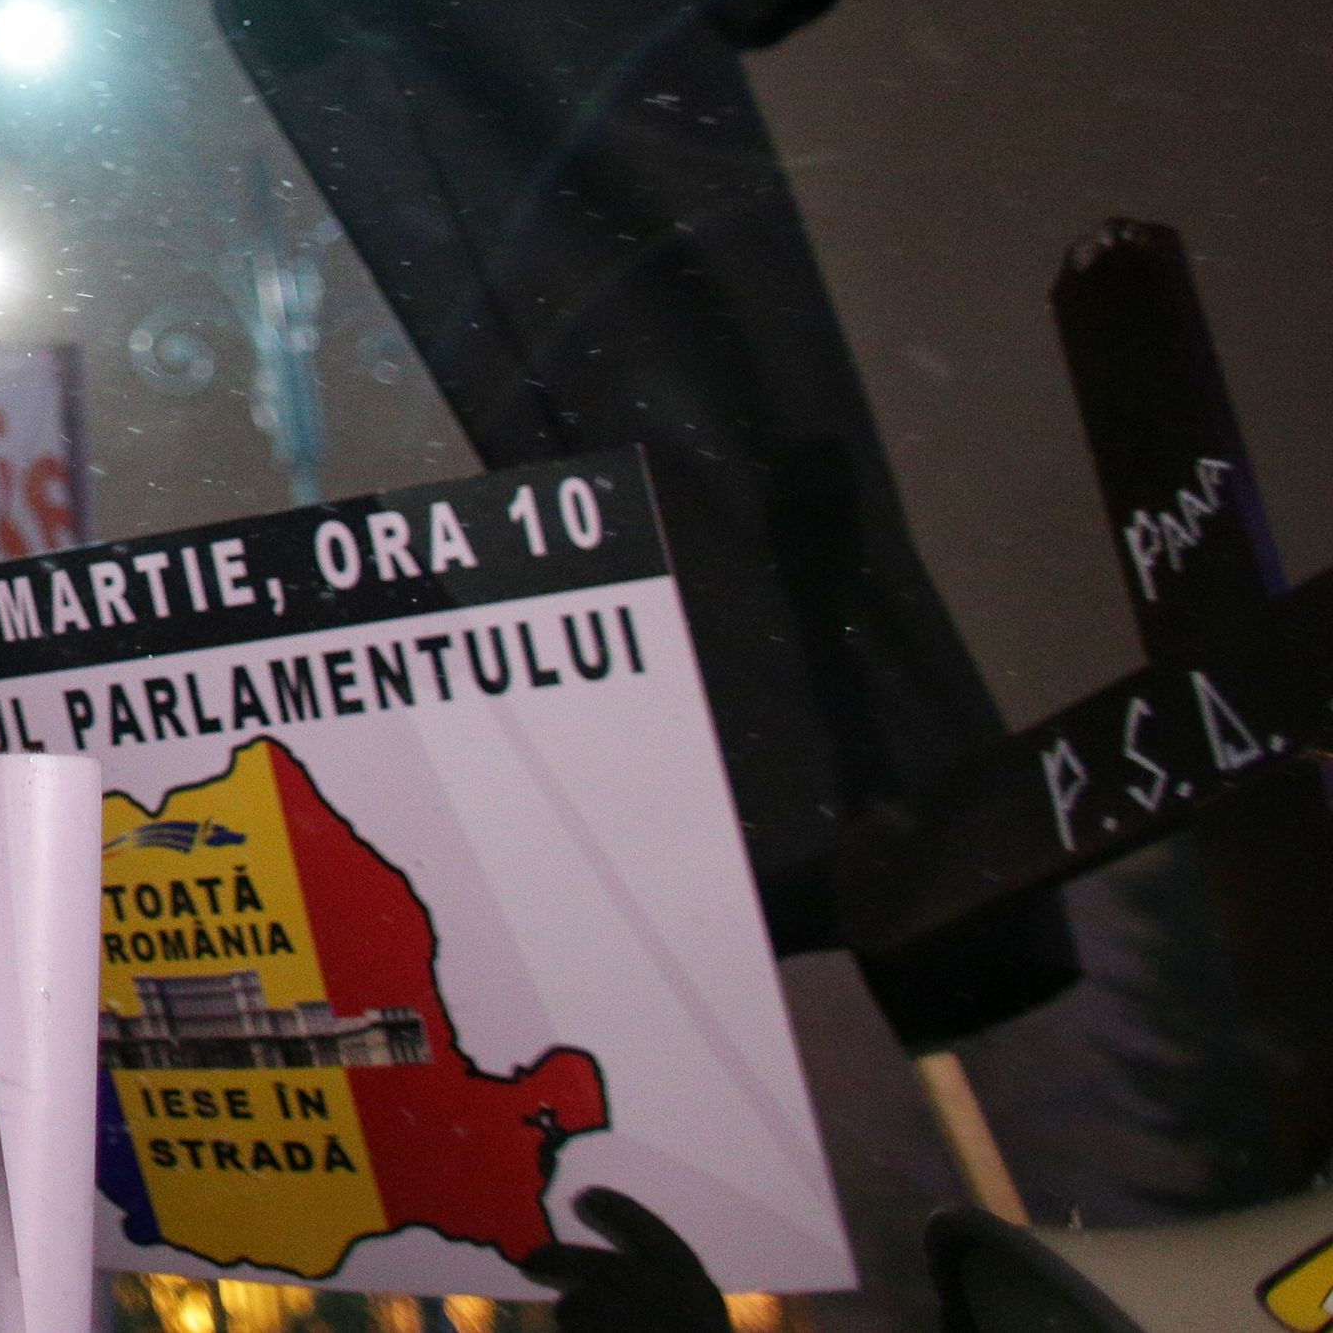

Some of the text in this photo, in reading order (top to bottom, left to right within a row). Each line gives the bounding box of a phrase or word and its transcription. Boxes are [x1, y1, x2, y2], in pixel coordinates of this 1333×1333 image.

[314, 500, 479, 591] ORA
[508, 476, 603, 558] 10
[64, 604, 646, 752] PARLAMENTULUI
[1042, 670, 1286, 852] P.S.D.
[102, 865, 264, 923] TOATĂ
[102, 918, 295, 965] ROMÂNIA
[140, 1081, 330, 1121] IESE ÎN
[148, 1133, 357, 1175] STRADĂ
